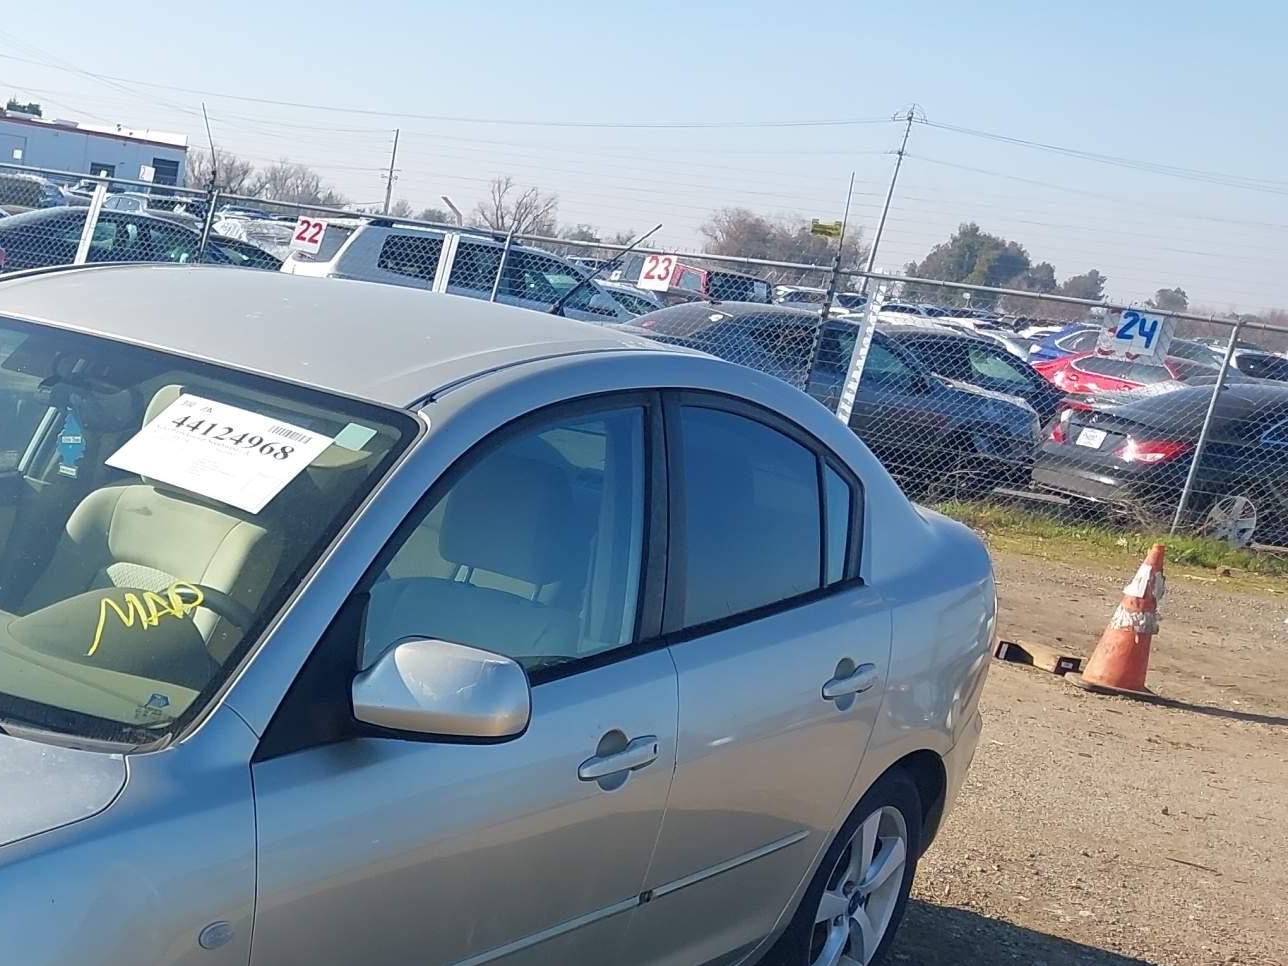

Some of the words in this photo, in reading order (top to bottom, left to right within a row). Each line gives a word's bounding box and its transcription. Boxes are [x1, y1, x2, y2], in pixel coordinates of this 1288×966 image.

[295, 219, 323, 244] 22
[643, 255, 673, 281] 23
[1116, 311, 1158, 349] 24
[171, 415, 295, 461] 44124968
